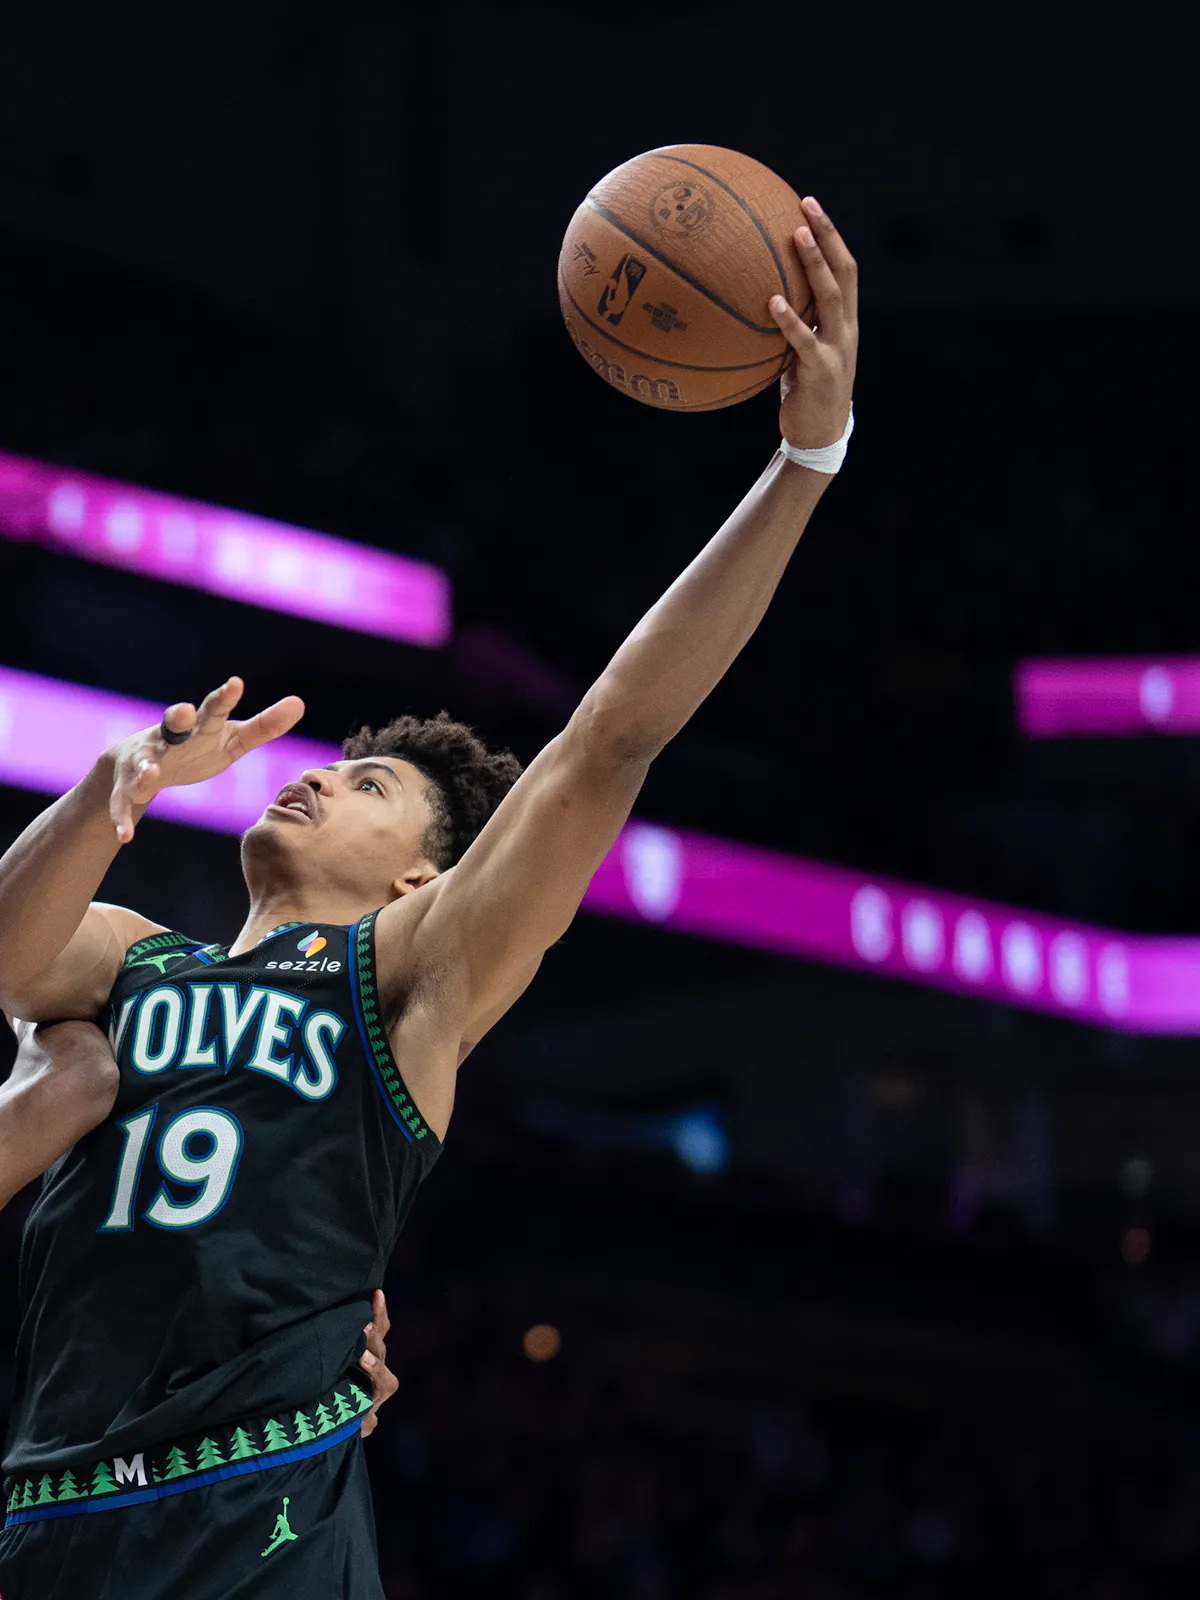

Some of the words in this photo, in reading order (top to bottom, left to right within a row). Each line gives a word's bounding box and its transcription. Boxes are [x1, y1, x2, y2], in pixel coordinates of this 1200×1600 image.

[264, 956, 341, 972] sezzle
[96, 1103, 245, 1232] 19
[113, 1453, 148, 1486] M
